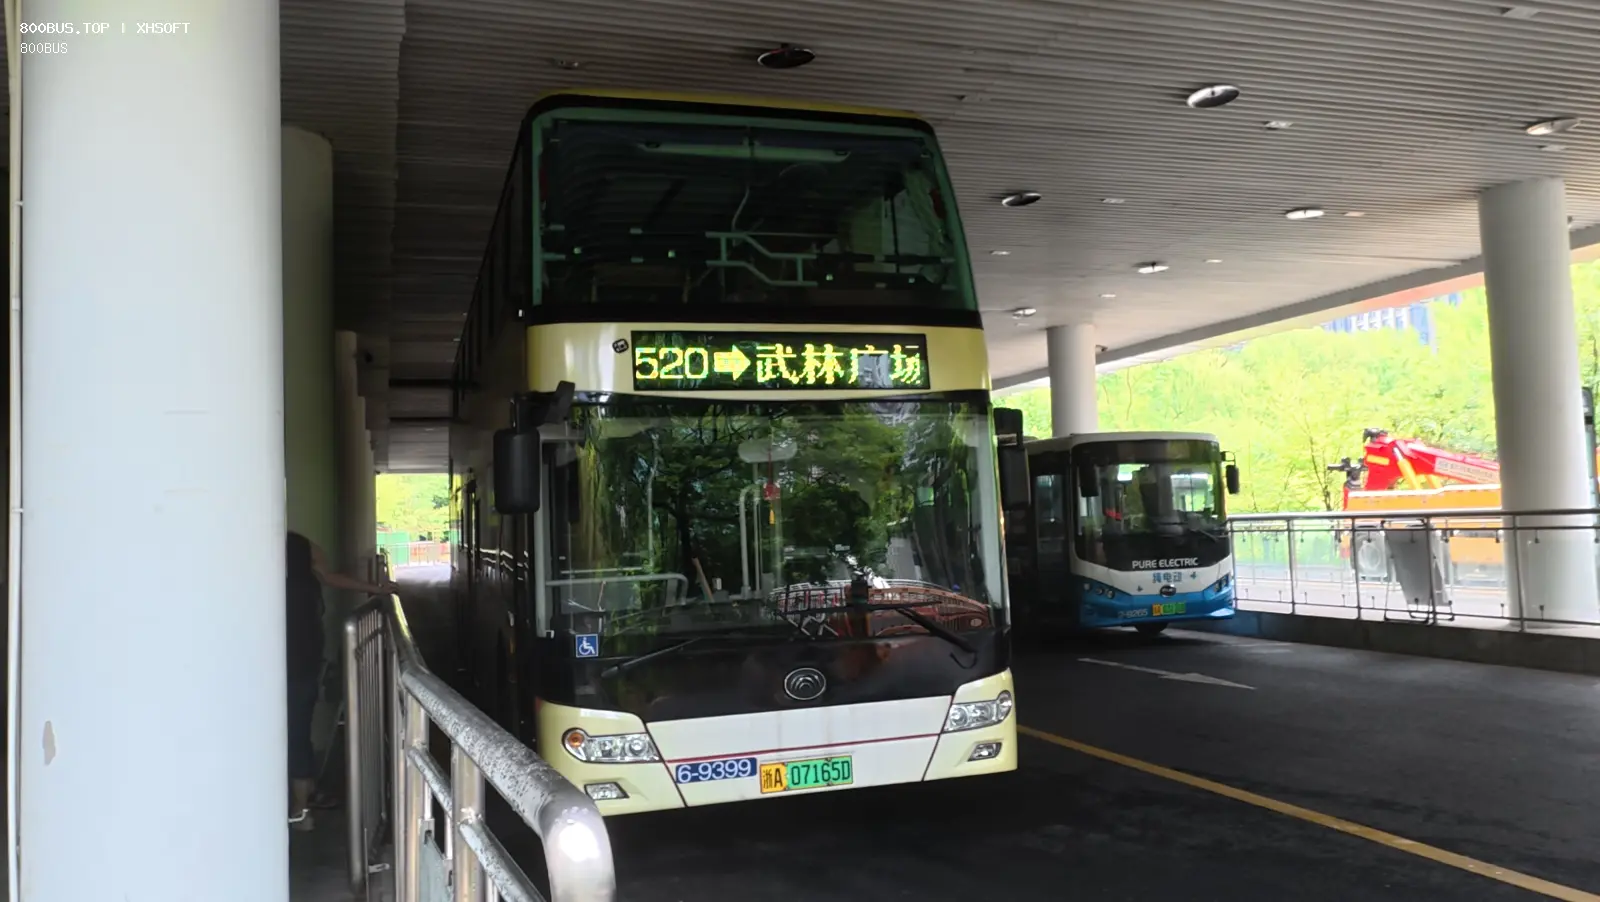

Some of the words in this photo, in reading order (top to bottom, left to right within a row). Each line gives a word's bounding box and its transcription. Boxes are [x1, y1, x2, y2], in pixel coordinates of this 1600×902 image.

[635, 347, 709, 379] 520
[755, 343, 921, 384] 武林广场
[1132, 560, 1157, 569] PURE
[1159, 557, 1198, 567] ELECTRIC
[677, 758, 751, 783] 6-9399
